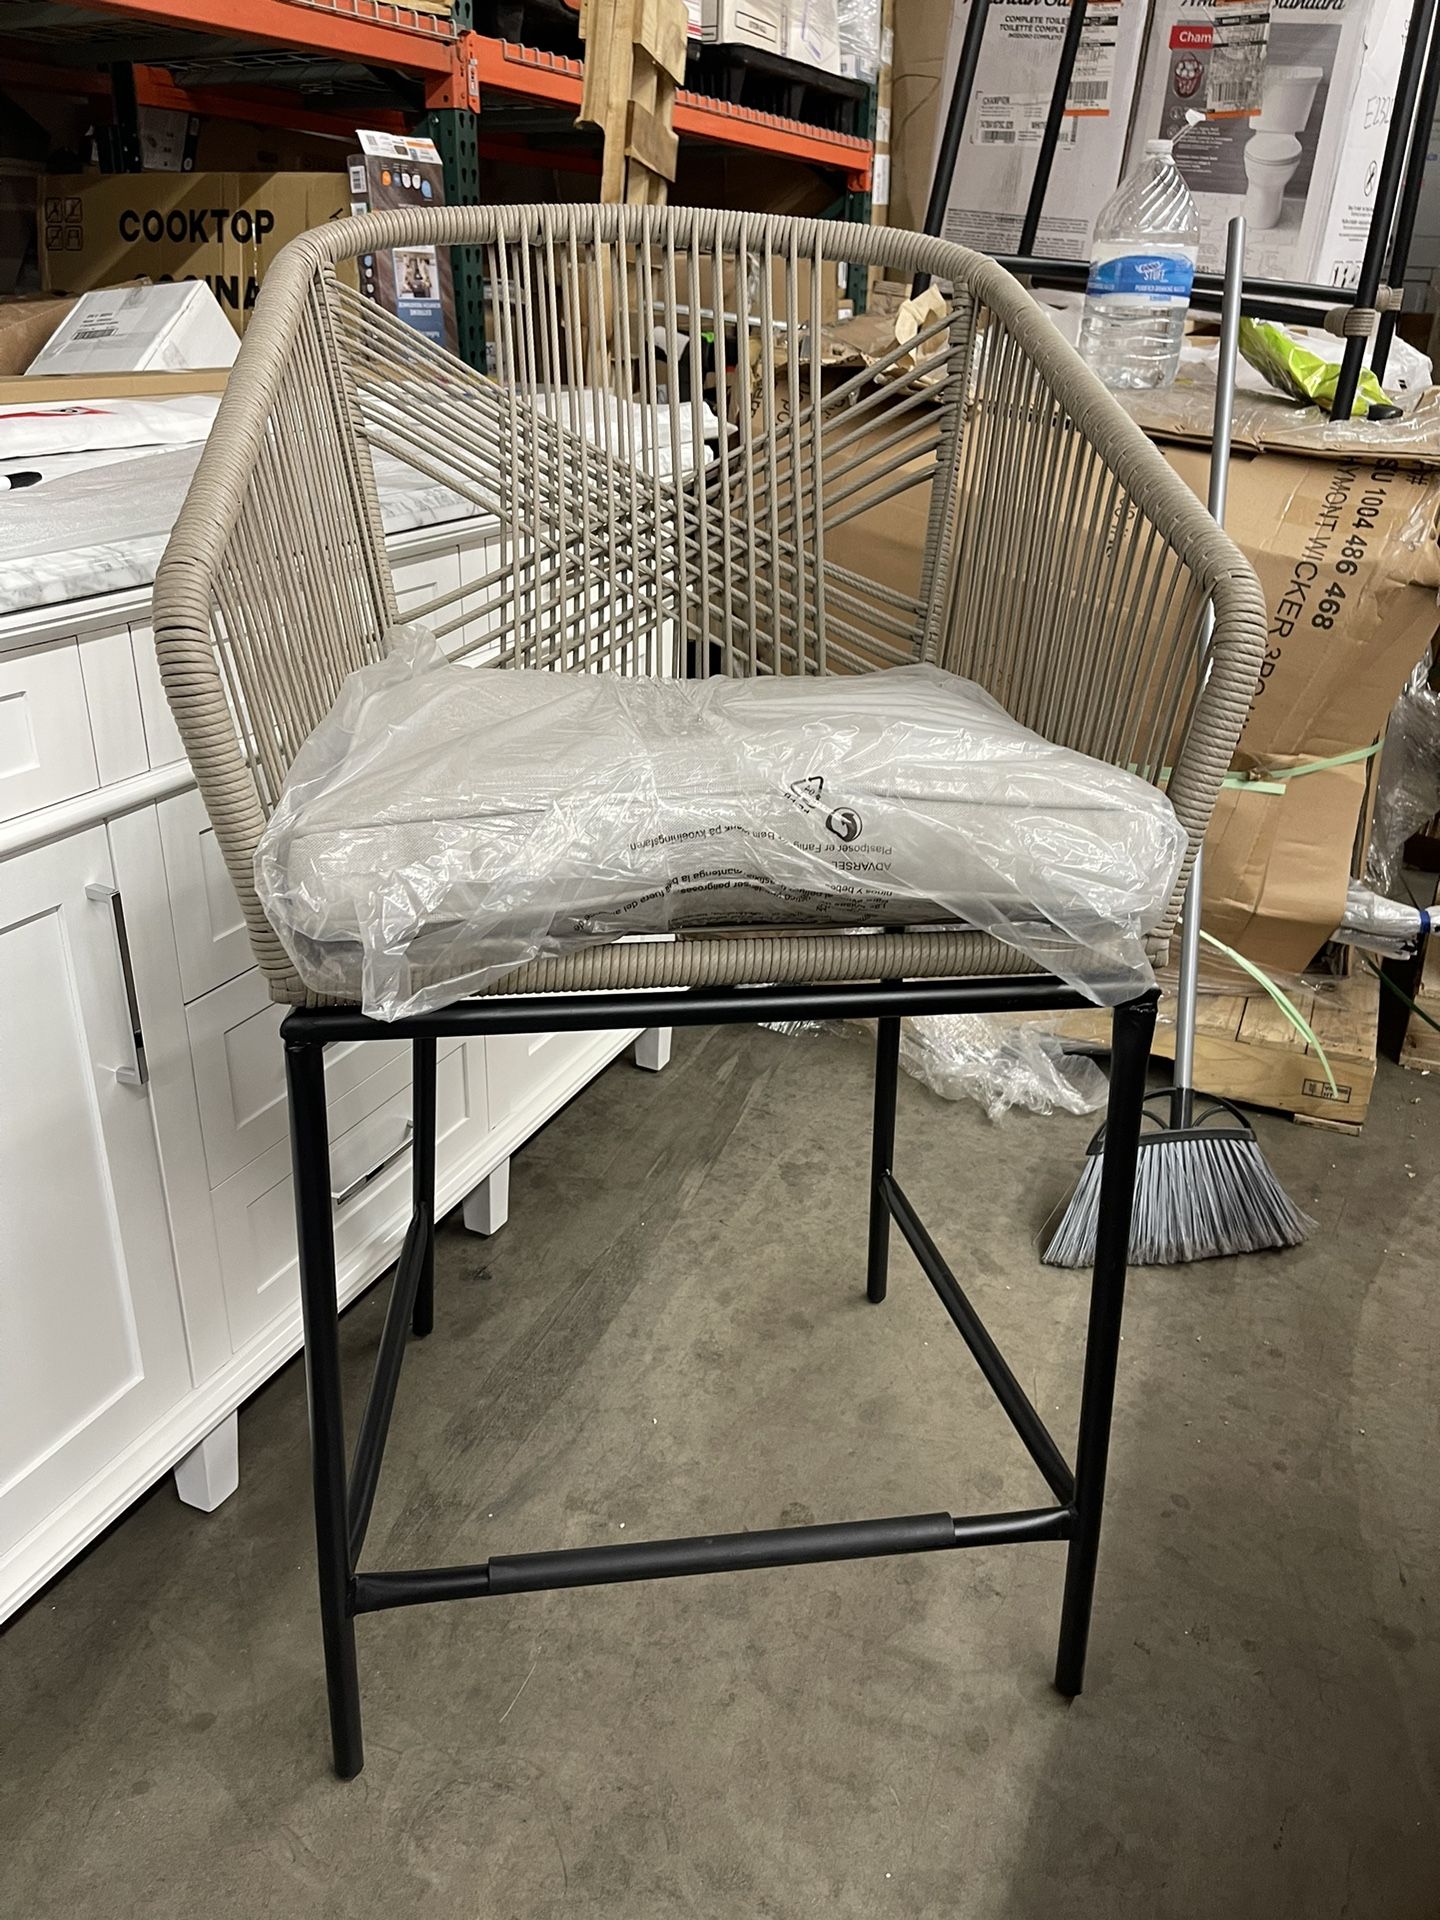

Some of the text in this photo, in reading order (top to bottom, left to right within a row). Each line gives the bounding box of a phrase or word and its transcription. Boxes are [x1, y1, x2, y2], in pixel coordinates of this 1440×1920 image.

[1000, 24, 1032, 32] TOILETTE
[119, 209, 275, 244] COOKTOP
[1314, 463, 1360, 532] YMONT
[1352, 488, 1387, 530] 1004
[1335, 534, 1368, 576] 486
[1269, 535, 1331, 638] WICKER
[1312, 582, 1346, 630] 468
[832, 861, 892, 871] ADVARSEL
[837, 844, 892, 855] Plastposer
[623, 900, 638, 912] del
[640, 890, 665, 904] fuera
